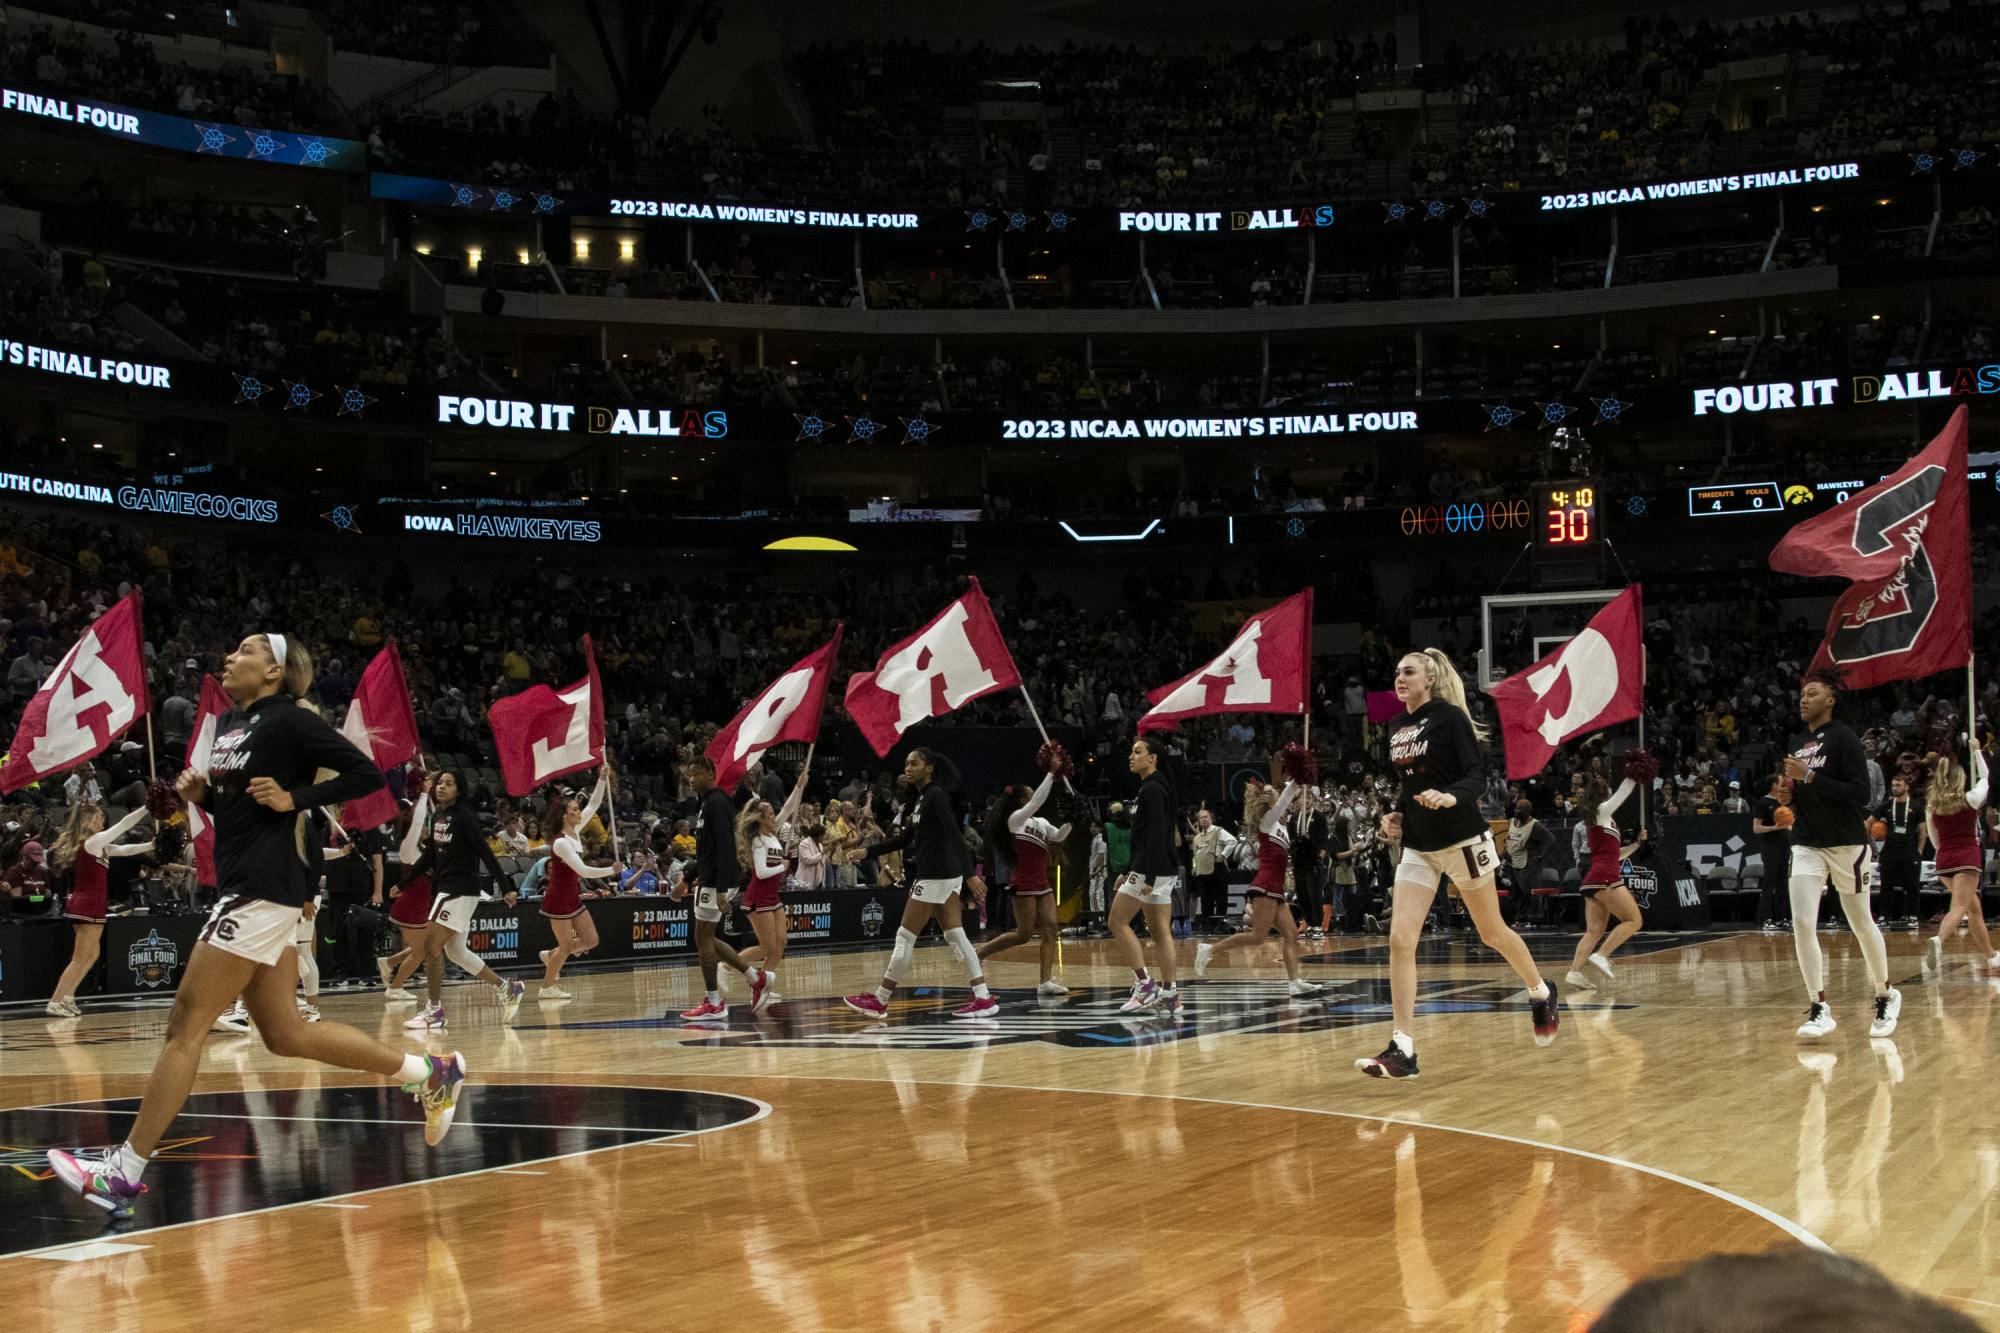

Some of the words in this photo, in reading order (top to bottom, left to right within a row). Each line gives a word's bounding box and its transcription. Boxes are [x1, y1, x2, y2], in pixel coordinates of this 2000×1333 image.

[2, 89, 73, 121] FINAL
[76, 104, 140, 135] FOUR
[1541, 193, 1589, 210] 2023
[1592, 187, 1646, 206] NCAA
[1647, 175, 1741, 199] WOMEN'S
[1743, 169, 1802, 189] FINAL
[1804, 163, 1860, 182] FOUR
[610, 199, 659, 216] 2023
[661, 202, 715, 219] NCAA
[716, 205, 806, 225] WOMEN'S
[808, 211, 865, 227] FINAL
[866, 213, 919, 228] FOUR
[1119, 211, 1192, 232] FOUR
[1195, 212, 1222, 231] IT
[1231, 206, 1334, 231] DALLAS
[27, 345, 97, 378] FINAL
[100, 359, 171, 388] FOUR
[1693, 382, 1797, 415] FOUR
[1800, 378, 1839, 407] IT
[1852, 364, 2000, 404] DALLAS
[438, 395, 536, 429] FOUR
[540, 403, 575, 432] IT
[588, 406, 728, 438] DALLAS
[1003, 419, 1066, 439] 2023
[1070, 419, 1141, 439] NCAA
[1143, 417, 1265, 438] WOMEN'S
[1269, 414, 1345, 435] FINAL
[1348, 411, 1419, 432] FOUR
[1697, 490, 1735, 499] TIMEOUTS
[1745, 487, 1770, 496] FOULS
[1816, 480, 1865, 491] HAWKEYES
[32, 477, 114, 504] CAROLINA
[117, 485, 279, 524] GAMECOCKS
[1711, 499, 1722, 511] 4
[1753, 496, 1763, 509] 0
[1836, 490, 1849, 505] 0
[404, 515, 455, 532] IOWA
[456, 513, 602, 543] HAWKEYES
[1548, 509, 1590, 543] 30
[1628, 877, 1655, 891] FOUR
[656, 909, 689, 922] DALLAS
[803, 902, 832, 914] DALLAS
[480, 917, 519, 931] DALLAS
[670, 922, 688, 938] DIII
[496, 931, 519, 949] DIII
[130, 951, 153, 967] FINAL
[154, 950, 175, 965] FOUR
